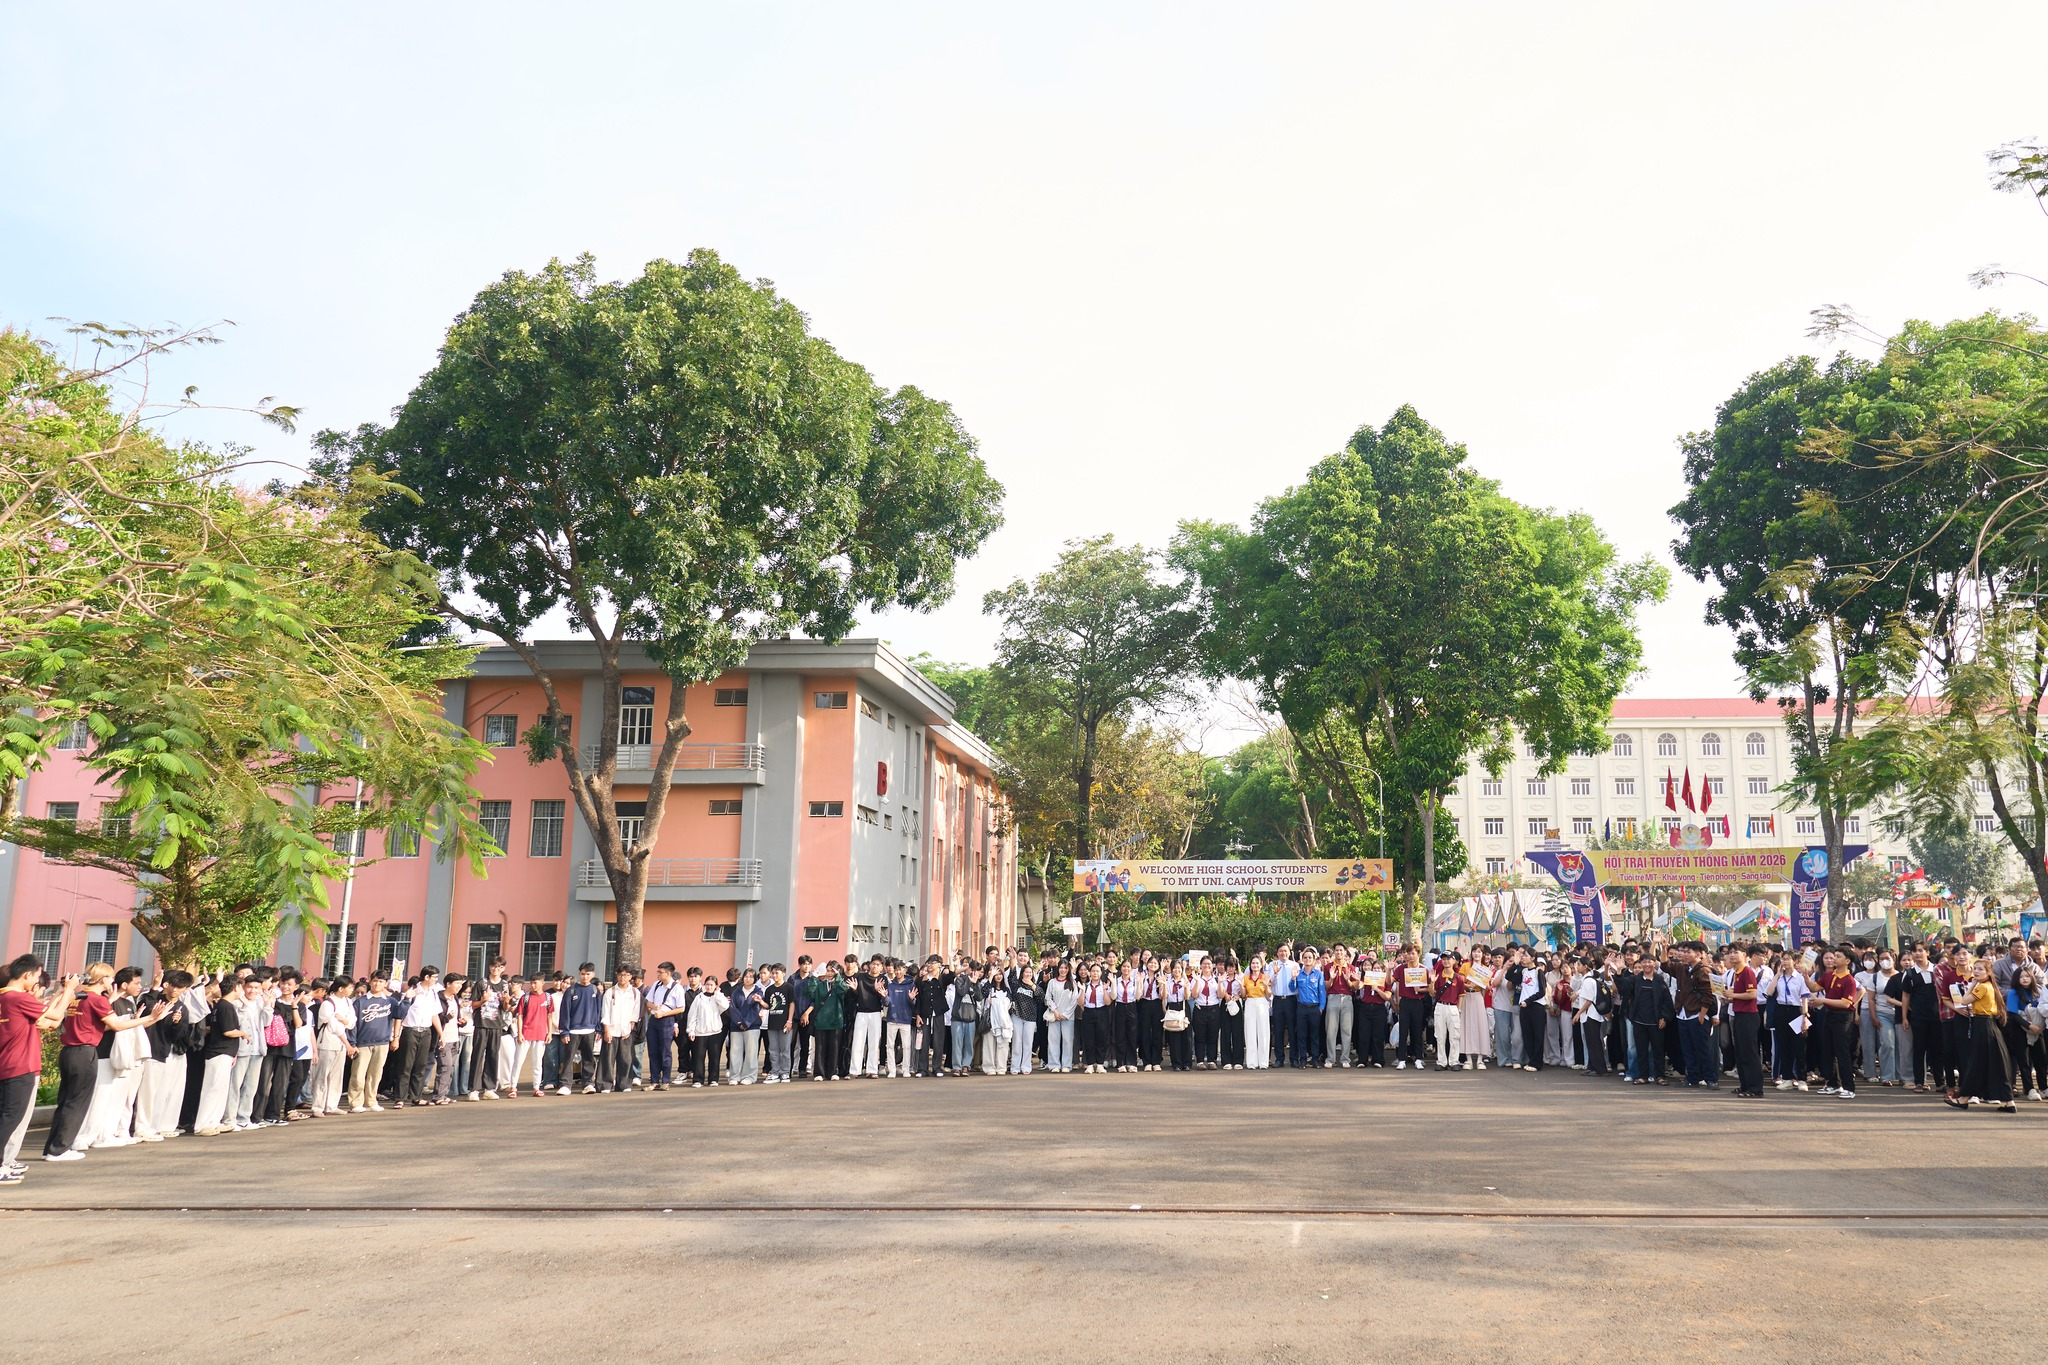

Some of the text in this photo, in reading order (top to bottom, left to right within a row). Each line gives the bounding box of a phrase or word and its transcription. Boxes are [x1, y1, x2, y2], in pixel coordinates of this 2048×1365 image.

[877, 761, 887, 796] B
[1604, 854, 1621, 871] HỘI
[1624, 857, 1647, 871] TRẠI
[1693, 851, 1728, 868] THỐNG
[1731, 853, 1757, 867] NĂM
[1760, 854, 1786, 866] 2026
[1139, 865, 1328, 874] WELCOME HIGH SCHOOL STUDENTS
[1161, 877, 1305, 886] TO MIT UNI. CAMPUS TOUR
[1715, 872, 1737, 882] phong
